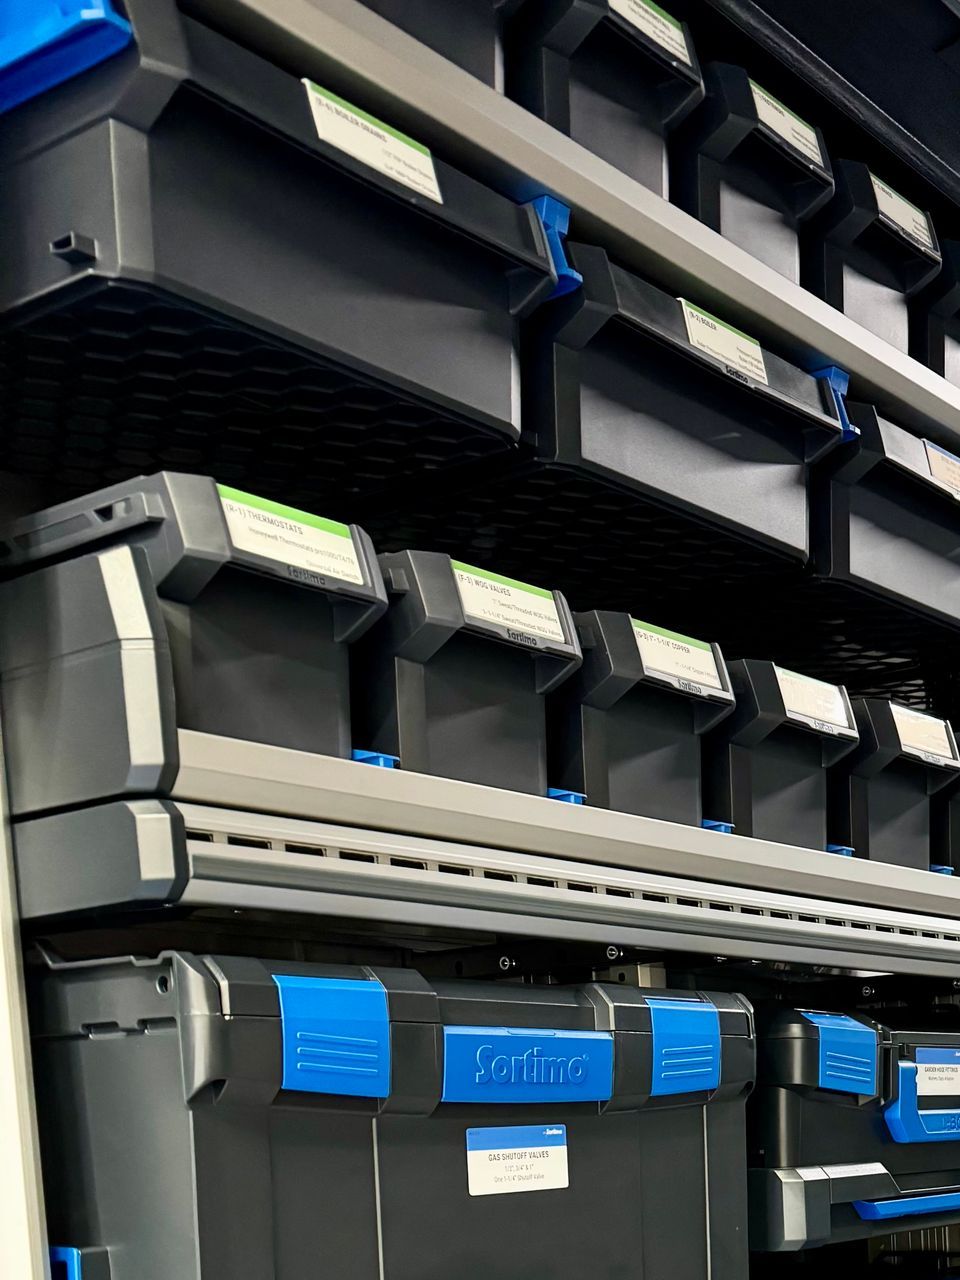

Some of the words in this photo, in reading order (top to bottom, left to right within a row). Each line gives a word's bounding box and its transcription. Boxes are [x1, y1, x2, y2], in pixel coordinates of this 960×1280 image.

[225, 503, 248, 521] (R-1)
[248, 510, 304, 536] THERMOSTATS
[489, 584, 512, 597] VALVES
[507, 629, 538, 646] Sortimo
[475, 1043, 588, 1085] Sortimo
[502, 1152, 527, 1160] SHUTOFF
[529, 1151, 549, 1159] VALVES
